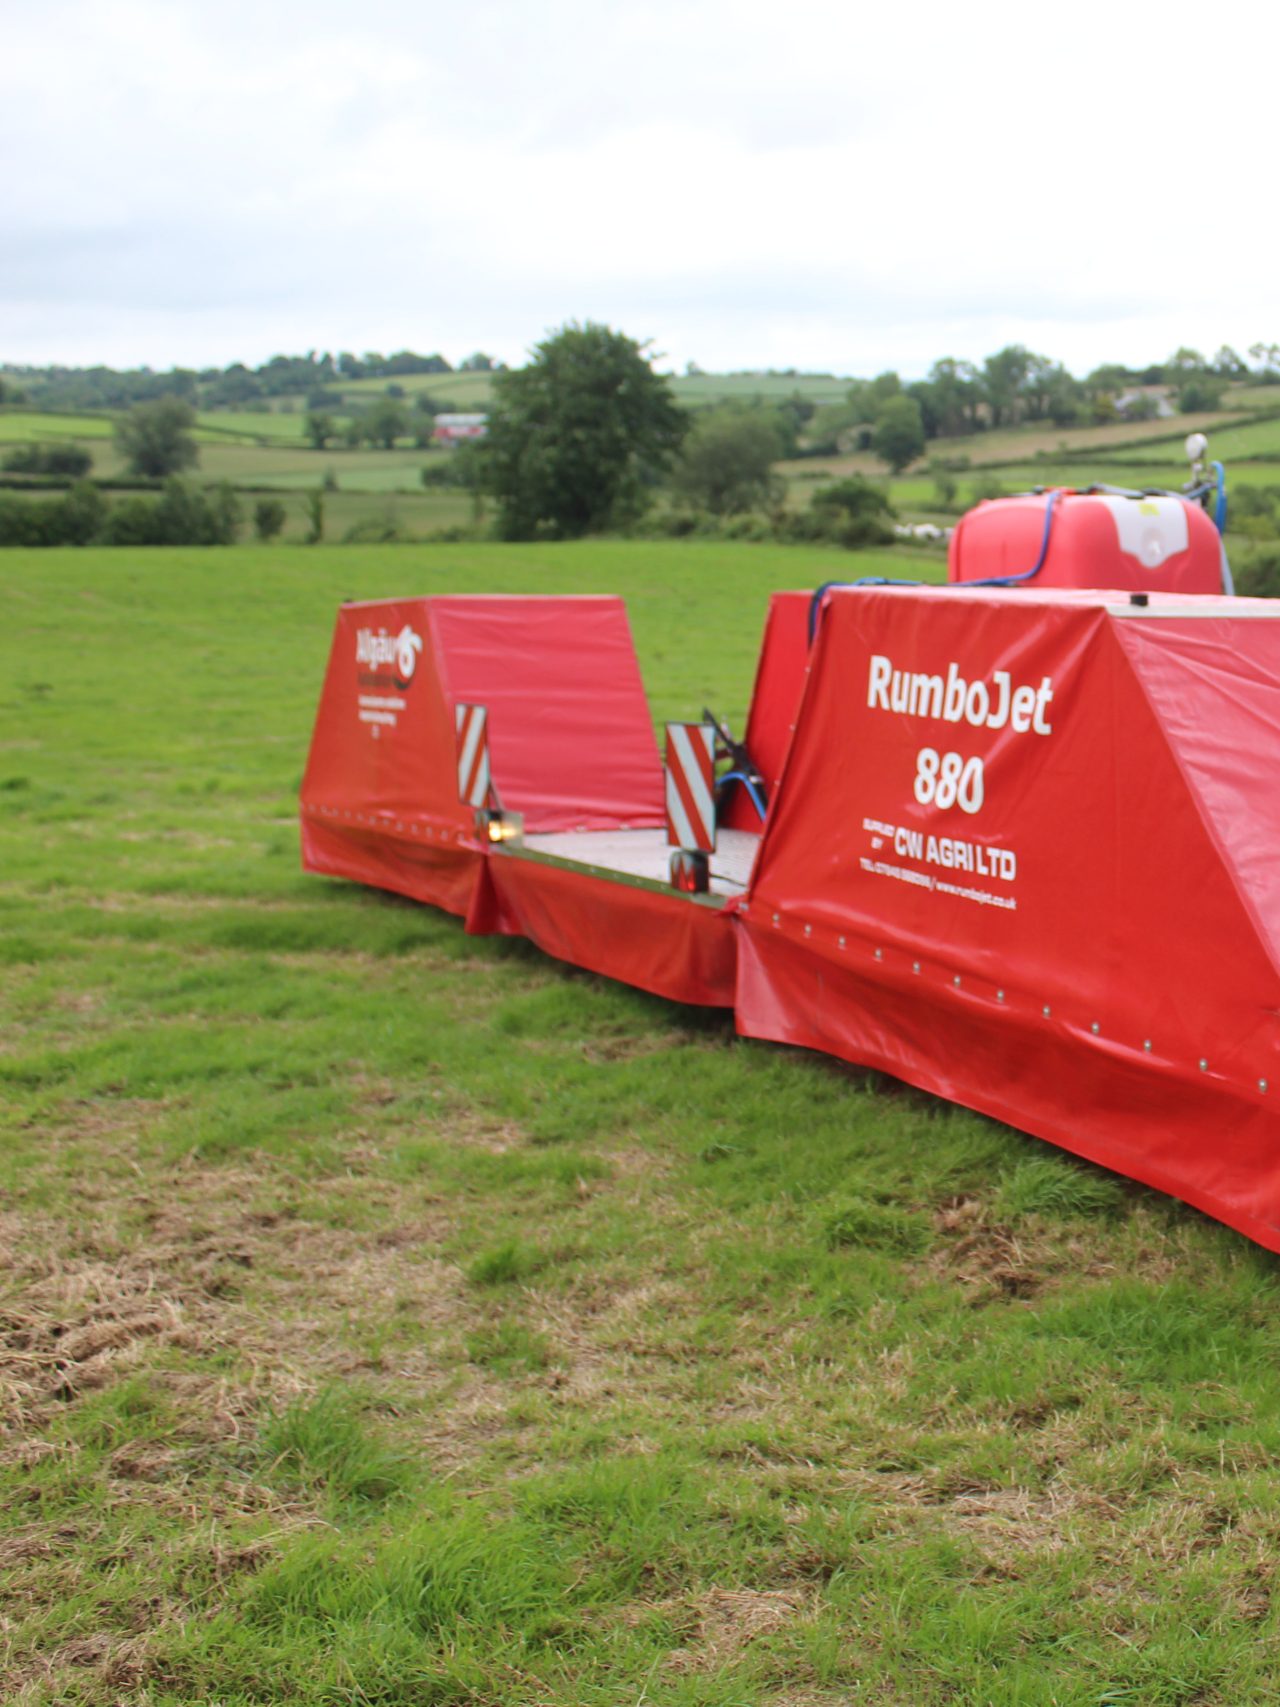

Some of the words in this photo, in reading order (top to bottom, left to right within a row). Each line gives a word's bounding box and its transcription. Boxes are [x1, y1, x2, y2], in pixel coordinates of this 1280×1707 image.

[867, 654, 1054, 735] RumboJet
[913, 747, 985, 814] 880
[894, 827, 924, 860] CW
[926, 835, 974, 872] AGRI
[976, 845, 1017, 881] LTD
